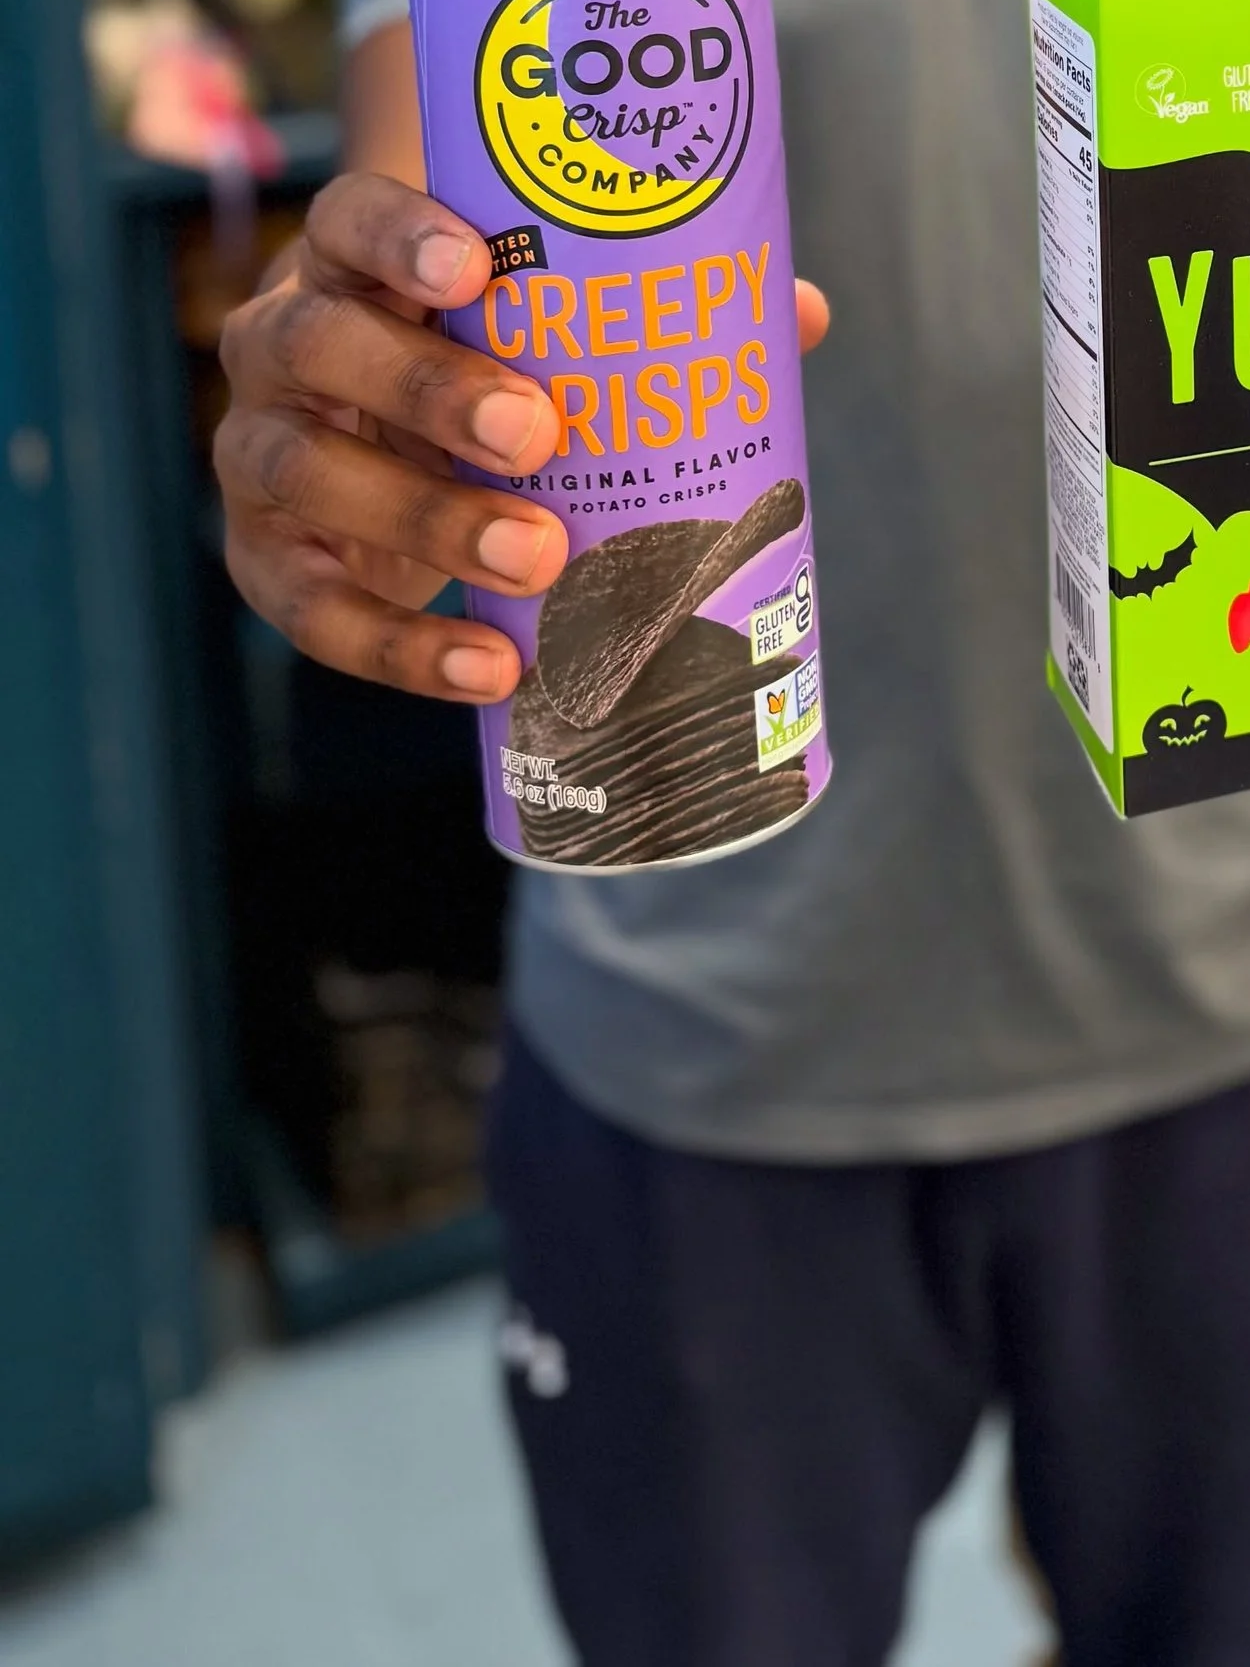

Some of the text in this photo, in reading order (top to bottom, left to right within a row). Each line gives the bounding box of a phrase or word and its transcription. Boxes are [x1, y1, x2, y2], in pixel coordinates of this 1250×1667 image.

[584, 0, 651, 31] The
[501, 26, 732, 99] GOOD
[1033, 25, 1064, 72] Nutrition
[1066, 56, 1091, 93] Facts
[1149, 95, 1210, 124] Vegan
[538, 124, 714, 195] COMPANY
[1079, 146, 1092, 172] 45
[490, 233, 530, 256] ITED
[493, 249, 536, 272] TION
[483, 241, 770, 359] CREEPY
[550, 339, 770, 457] RISPS
[510, 435, 772, 491] ORIGINAL FLAVOR
[570, 480, 727, 514] POTATO CRISPS
[754, 585, 791, 610] CERTIFIED
[756, 599, 796, 635] GLUTEN
[757, 629, 784, 656] FREE
[797, 657, 818, 685] NON
[798, 674, 819, 702] GMO
[500, 746, 559, 782] NET WT.
[503, 772, 607, 813] 5.6 oz (160g)
